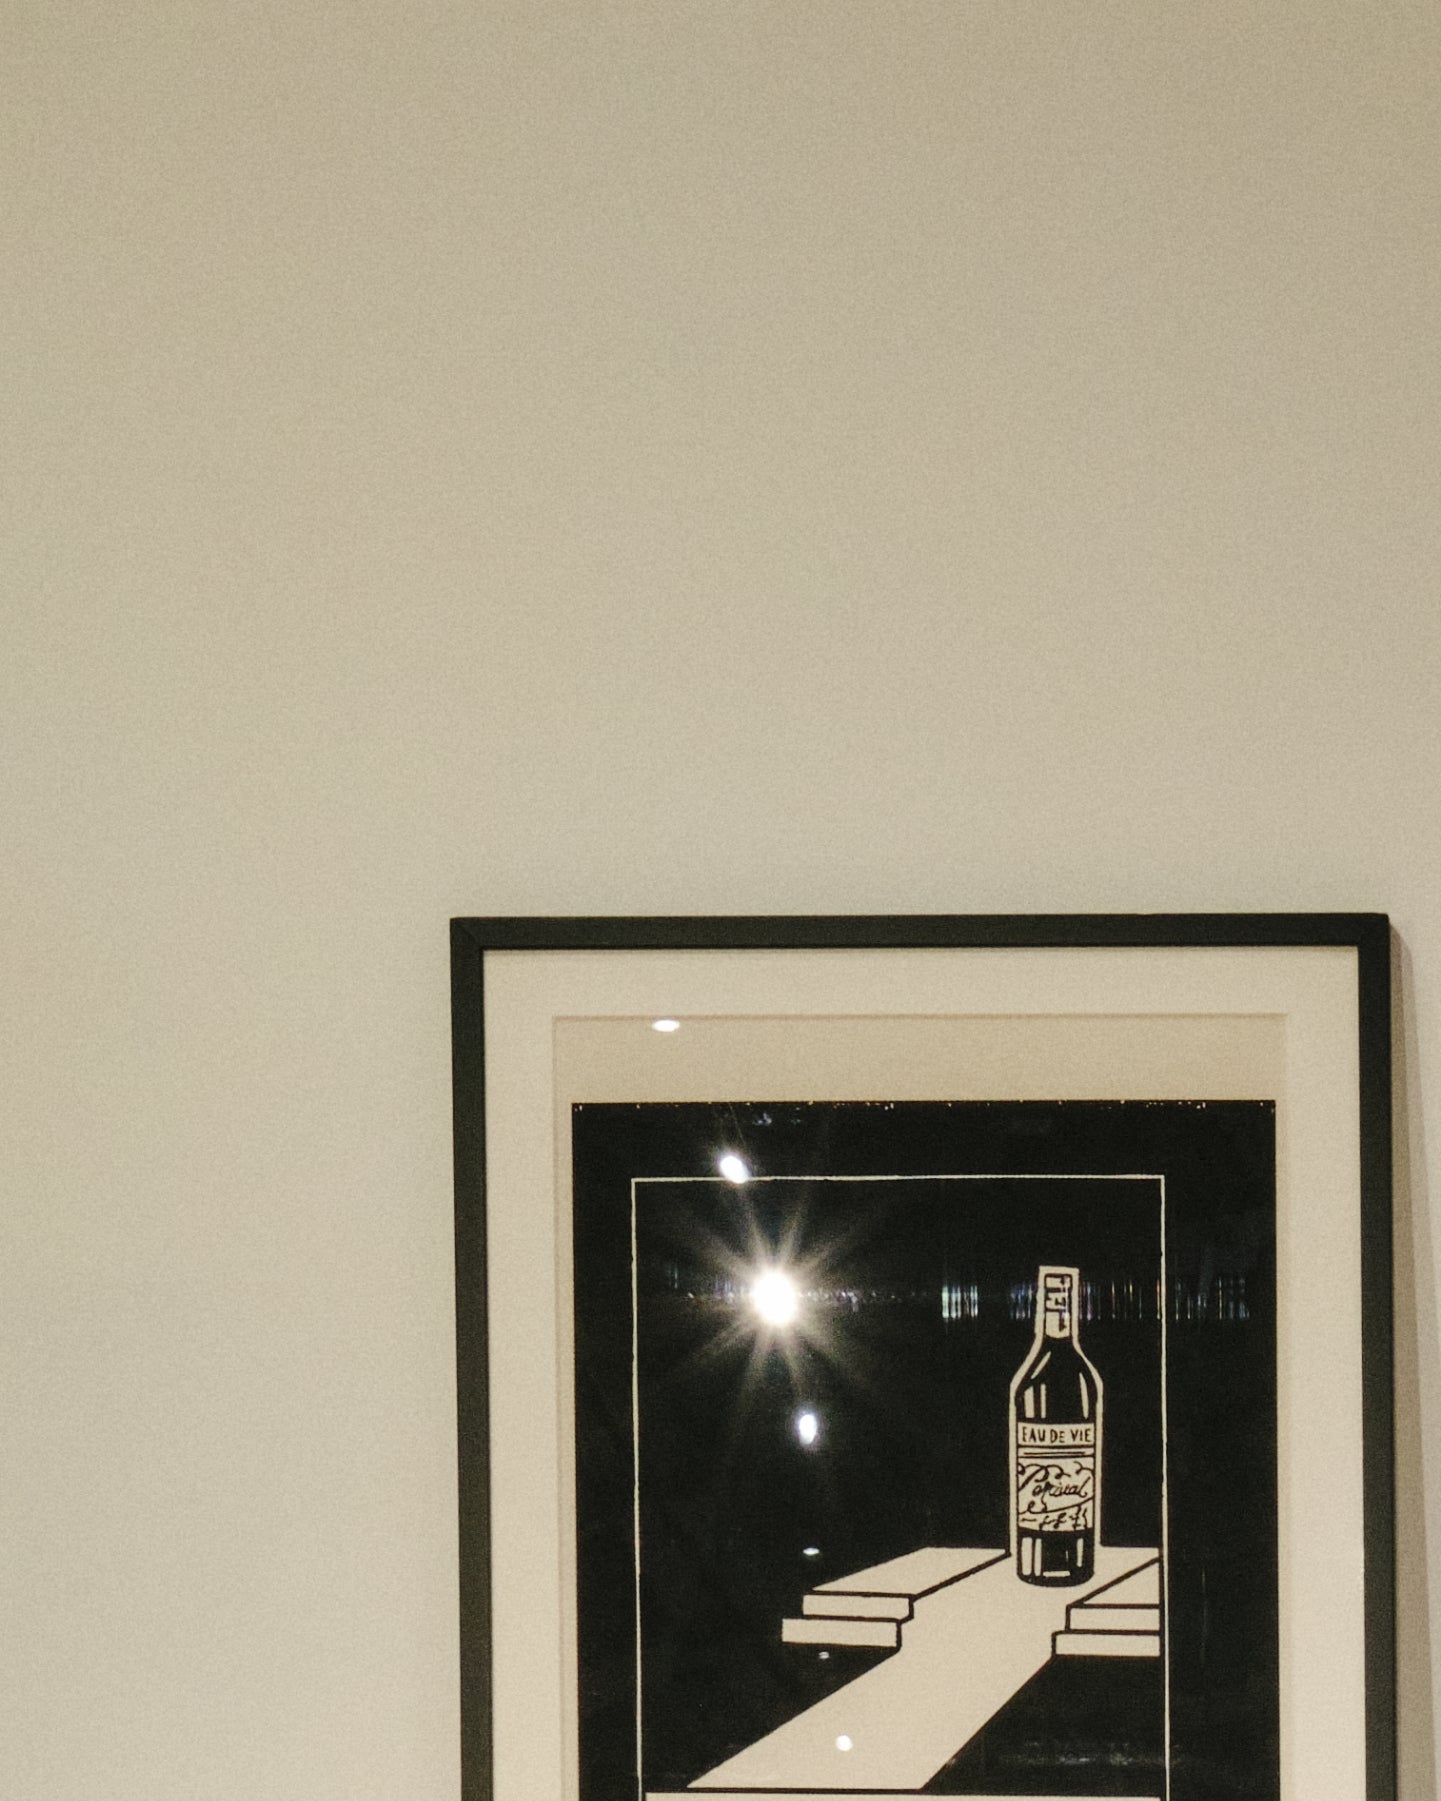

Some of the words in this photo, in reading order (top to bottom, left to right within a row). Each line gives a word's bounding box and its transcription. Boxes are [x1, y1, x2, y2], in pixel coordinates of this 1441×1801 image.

[1022, 1426, 1046, 1442] EAU
[1050, 1428, 1066, 1443] DE
[1070, 1428, 1091, 1442] VIE
